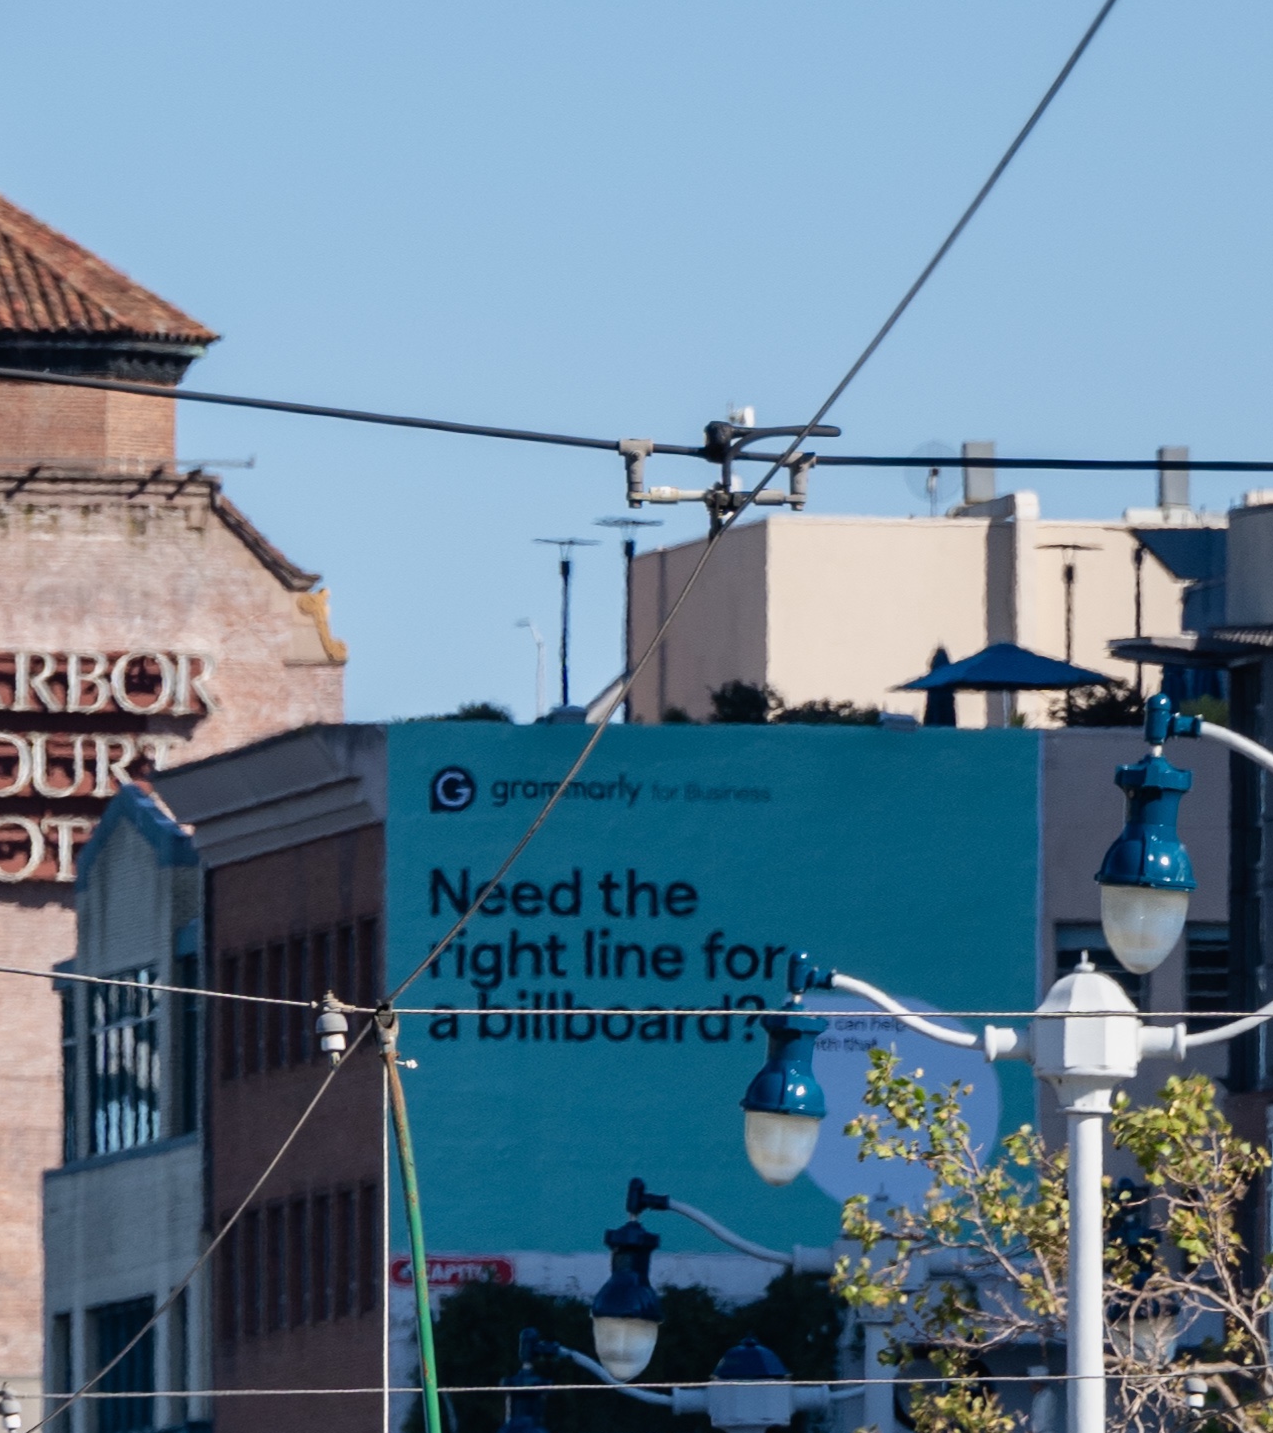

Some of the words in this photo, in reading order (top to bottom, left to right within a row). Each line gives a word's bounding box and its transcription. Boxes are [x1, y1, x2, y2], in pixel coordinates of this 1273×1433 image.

[429, 868, 582, 918] Need
[597, 868, 699, 918] the
[428, 927, 567, 990] right
[584, 927, 685, 980] line
[703, 930, 787, 981] for
[428, 1004, 459, 1041] a
[478, 989, 767, 1043] billboard?
